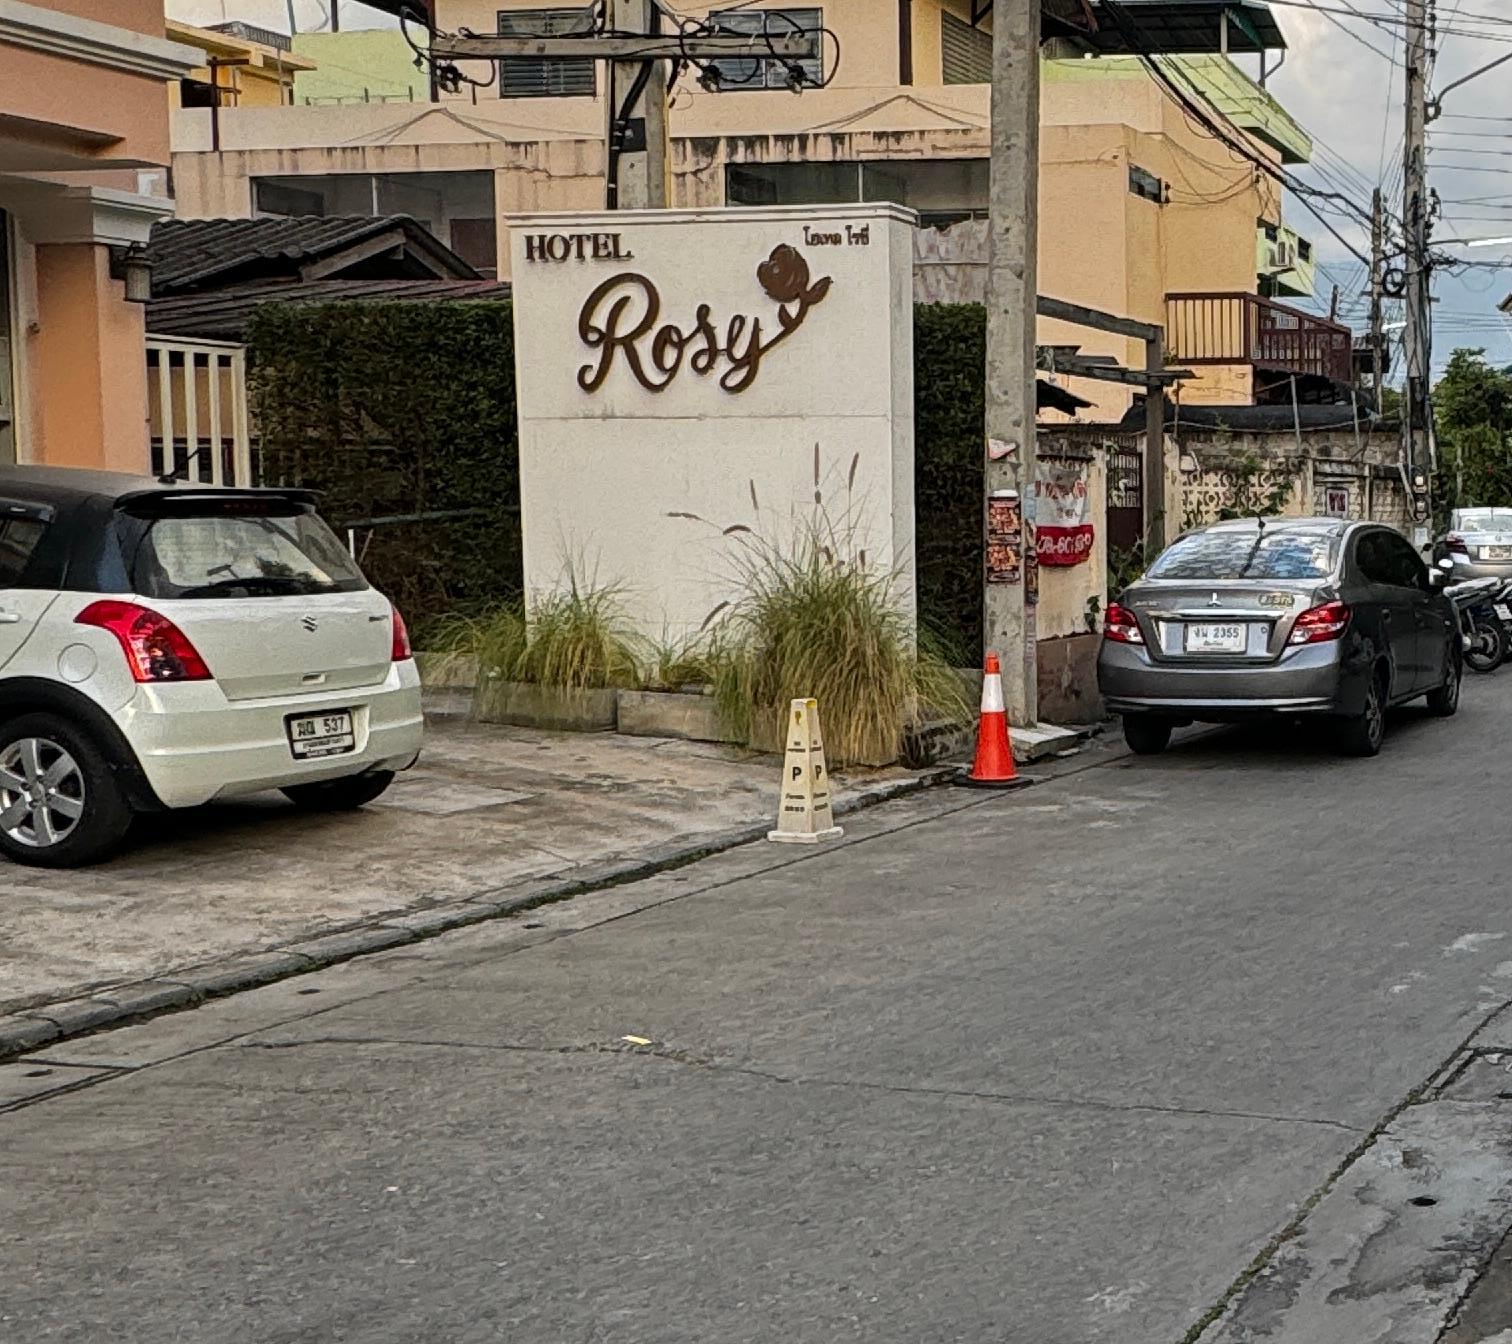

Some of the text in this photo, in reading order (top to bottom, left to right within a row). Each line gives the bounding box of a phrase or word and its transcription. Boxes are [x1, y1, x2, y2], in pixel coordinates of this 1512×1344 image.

[525, 233, 634, 262] HOTEL
[576, 272, 764, 394] Rosy
[322, 716, 345, 734] 537
[792, 767, 802, 781] P
[815, 765, 822, 780] P
